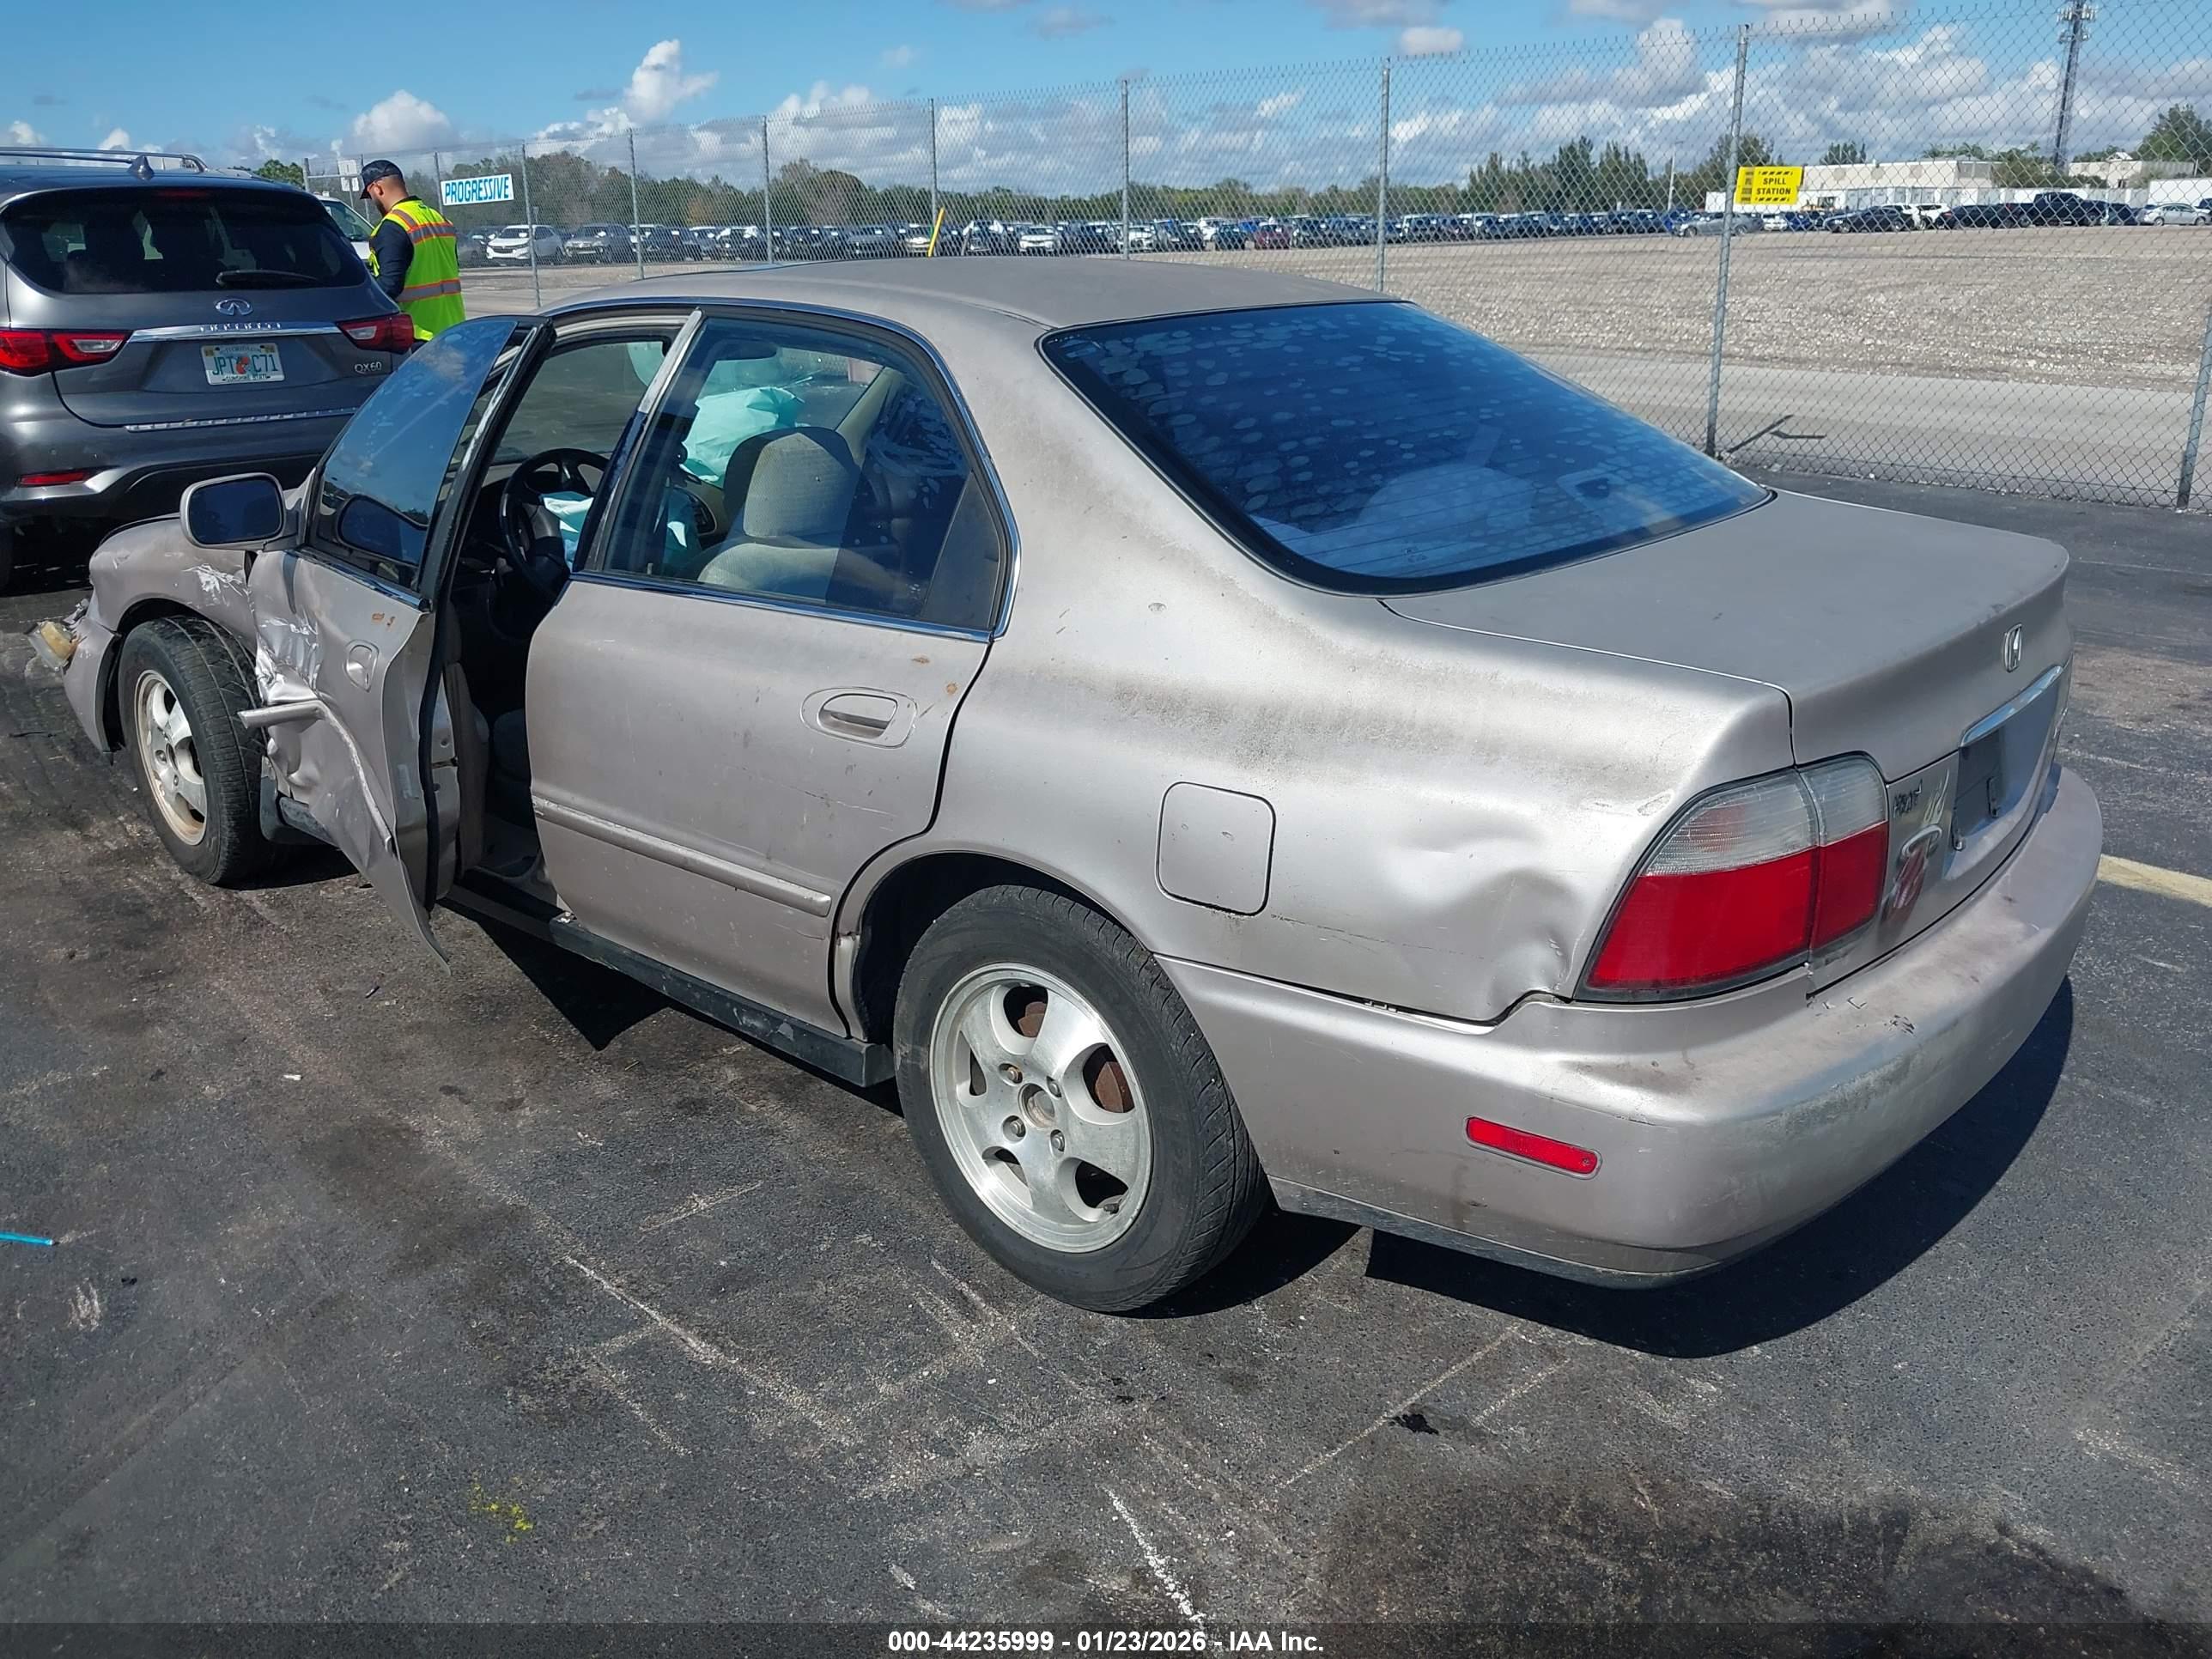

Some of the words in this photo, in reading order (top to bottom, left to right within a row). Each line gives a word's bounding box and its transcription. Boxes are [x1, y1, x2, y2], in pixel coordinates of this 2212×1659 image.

[445, 176, 510, 204] PROGRESSIVE
[212, 356, 235, 376] JPT
[251, 354, 279, 373] C71
[354, 361, 383, 374] QX60
